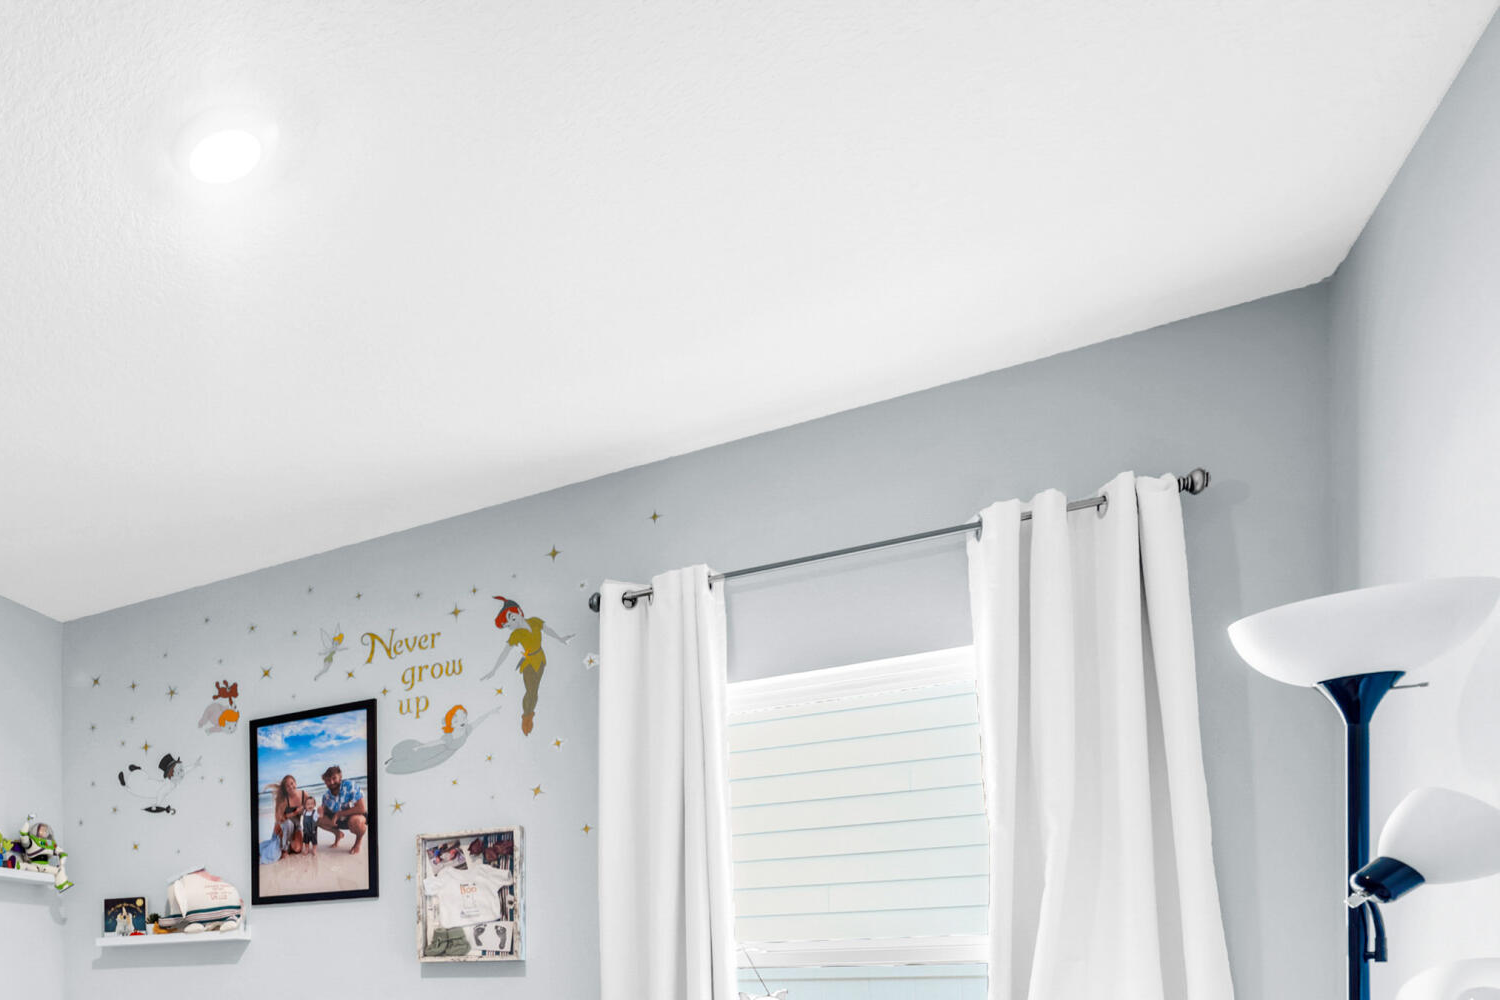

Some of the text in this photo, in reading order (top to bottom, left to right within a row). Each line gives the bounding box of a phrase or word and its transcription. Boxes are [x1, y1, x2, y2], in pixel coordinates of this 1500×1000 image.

[360, 628, 441, 664] Never
[401, 658, 463, 691] grow
[399, 696, 429, 719] up
